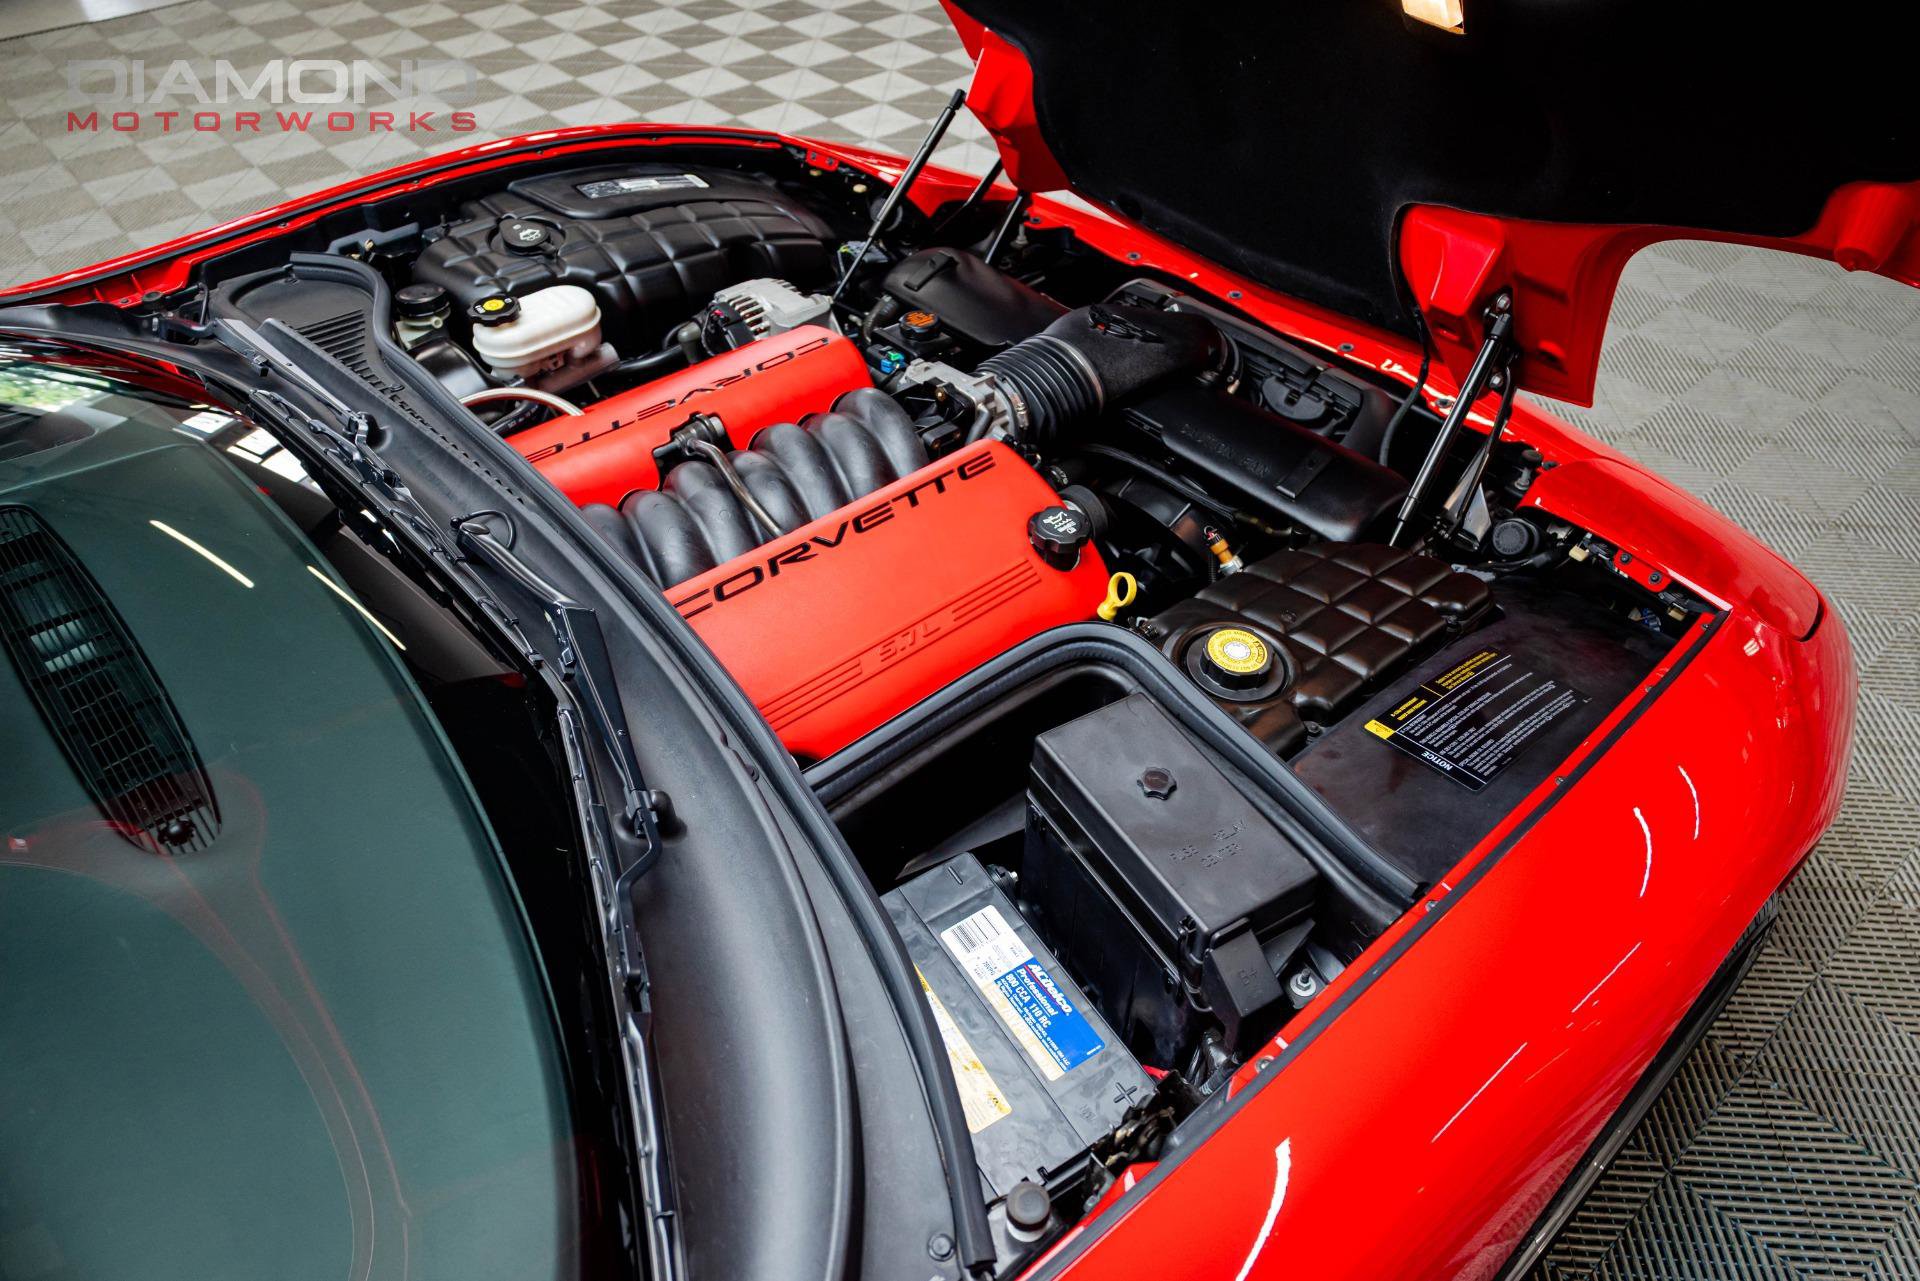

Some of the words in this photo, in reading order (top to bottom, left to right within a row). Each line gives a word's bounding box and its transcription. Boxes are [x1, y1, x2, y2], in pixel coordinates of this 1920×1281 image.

[525, 337, 830, 463] CORVETTE
[673, 451, 996, 619] CORVETTE
[880, 624, 941, 662] 5.7L
[1421, 750, 1453, 771] NOTICE
[1005, 973, 1019, 987] 800
[1015, 985, 1031, 1002] CCA
[1030, 1003, 1043, 1017] 110
[1038, 1015, 1051, 1027] RC
[1016, 968, 1058, 1015] Professional
[1027, 965, 1072, 1013] ACDelco
